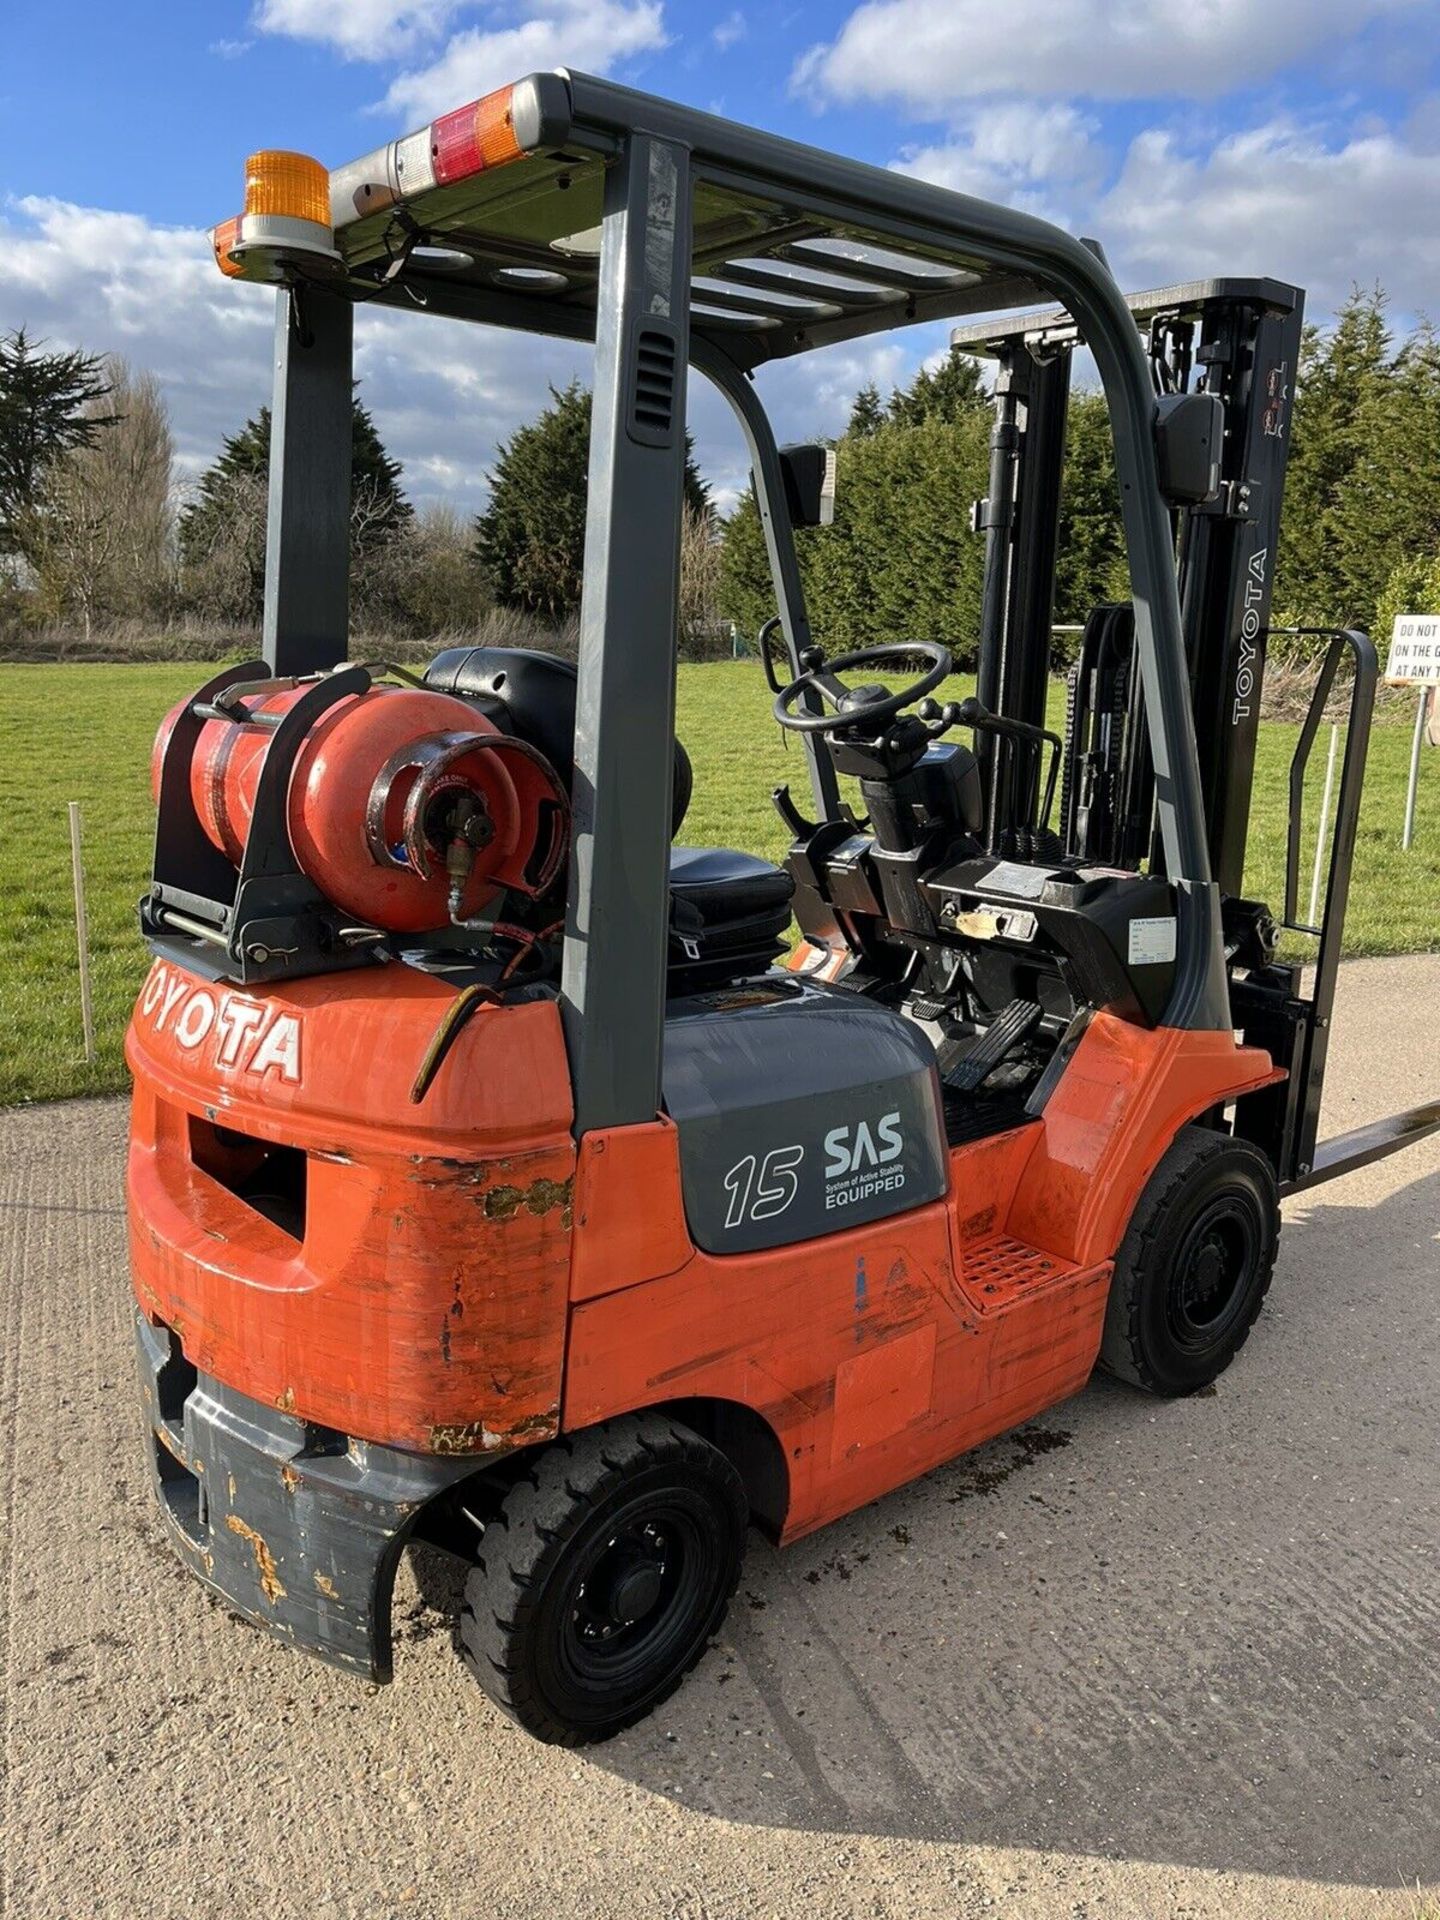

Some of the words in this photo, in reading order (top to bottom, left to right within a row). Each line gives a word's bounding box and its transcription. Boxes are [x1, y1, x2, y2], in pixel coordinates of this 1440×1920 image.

[1232, 548, 1268, 725] TOYOTA
[1400, 624, 1414, 636] DO
[1416, 624, 1438, 637] NOT
[1395, 645, 1409, 656] ON
[1413, 645, 1431, 657] THE
[1395, 665, 1409, 676] AT
[1411, 665, 1432, 677] ANY
[141, 962, 302, 1084] OYOTA
[824, 1111, 904, 1179] SAS
[724, 1144, 804, 1229] 15
[825, 1181, 850, 1195] System
[851, 1175, 859, 1186] of
[859, 1172, 879, 1183] Active
[879, 1163, 904, 1177] Stability
[825, 1174, 905, 1210] EQUIPPED
